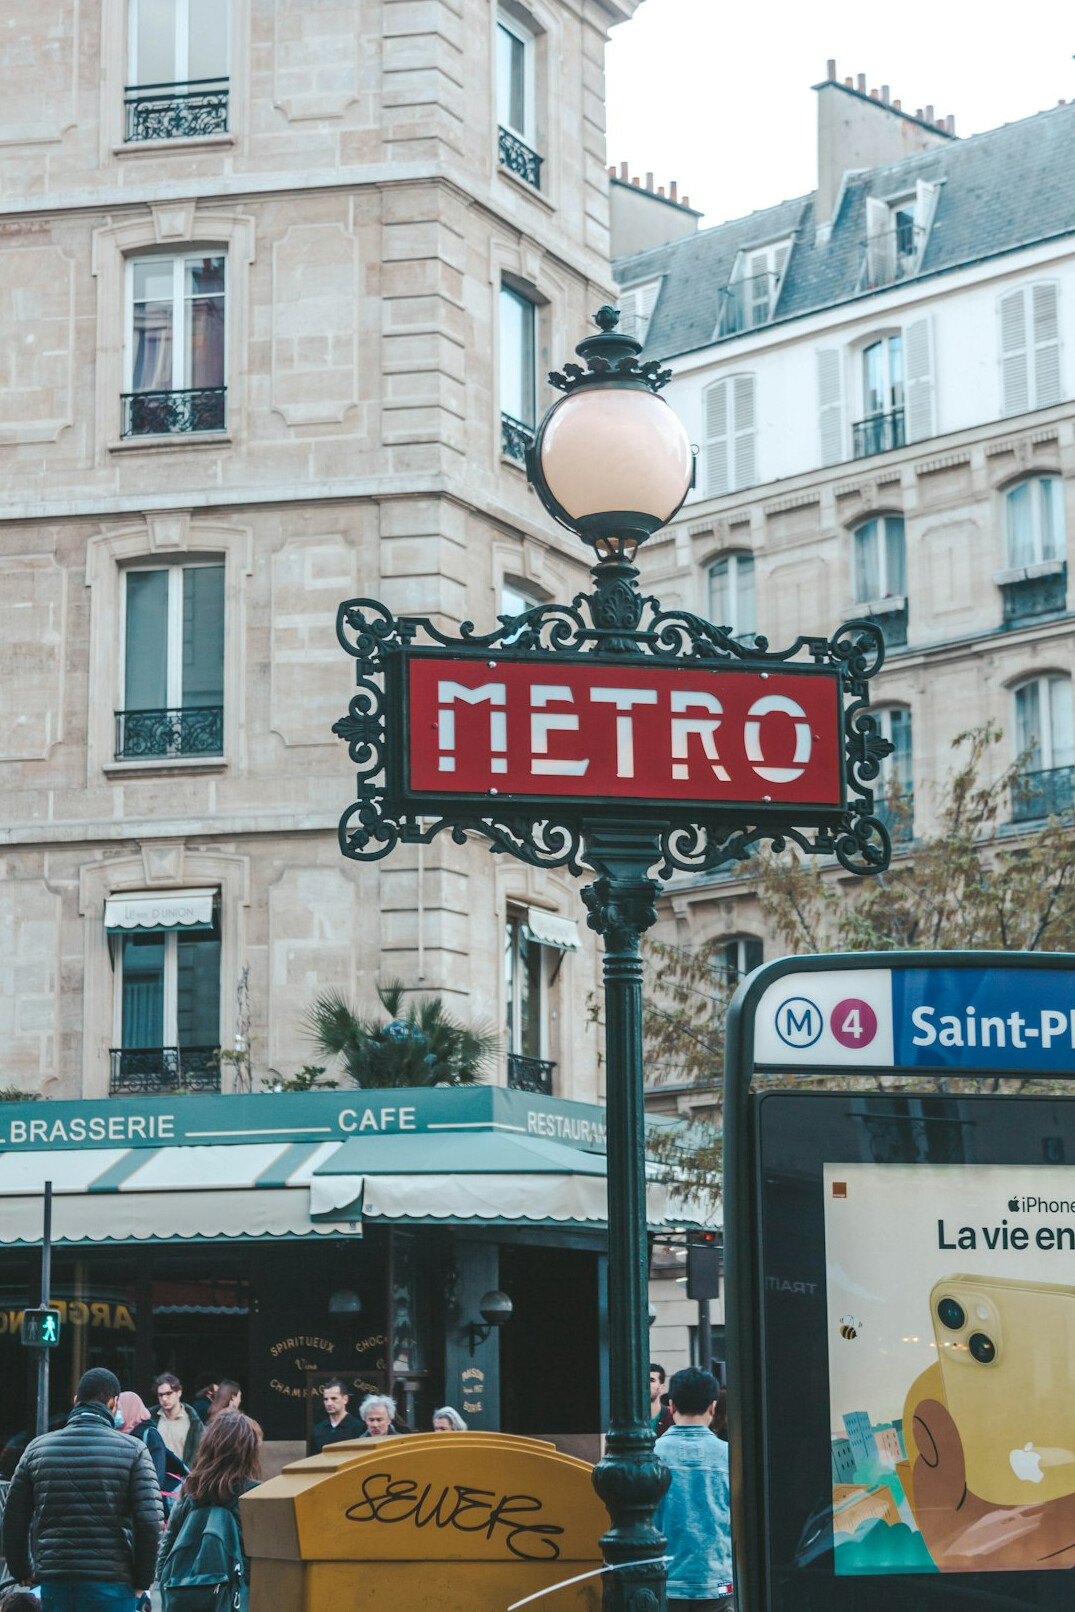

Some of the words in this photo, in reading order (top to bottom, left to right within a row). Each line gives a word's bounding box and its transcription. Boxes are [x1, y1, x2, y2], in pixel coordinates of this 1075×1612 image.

[438, 680, 812, 783] METRO
[841, 1009, 863, 1038] 4
[9, 1115, 175, 1143] BRASSERIE
[338, 1106, 416, 1132] CAFE
[527, 1111, 607, 1144] RESTAURAN
[937, 1219, 976, 1251] La
[982, 1218, 1029, 1251] vie
[1035, 1227, 1075, 1251] en
[269, 1335, 336, 1357] SPIRITUEUX
